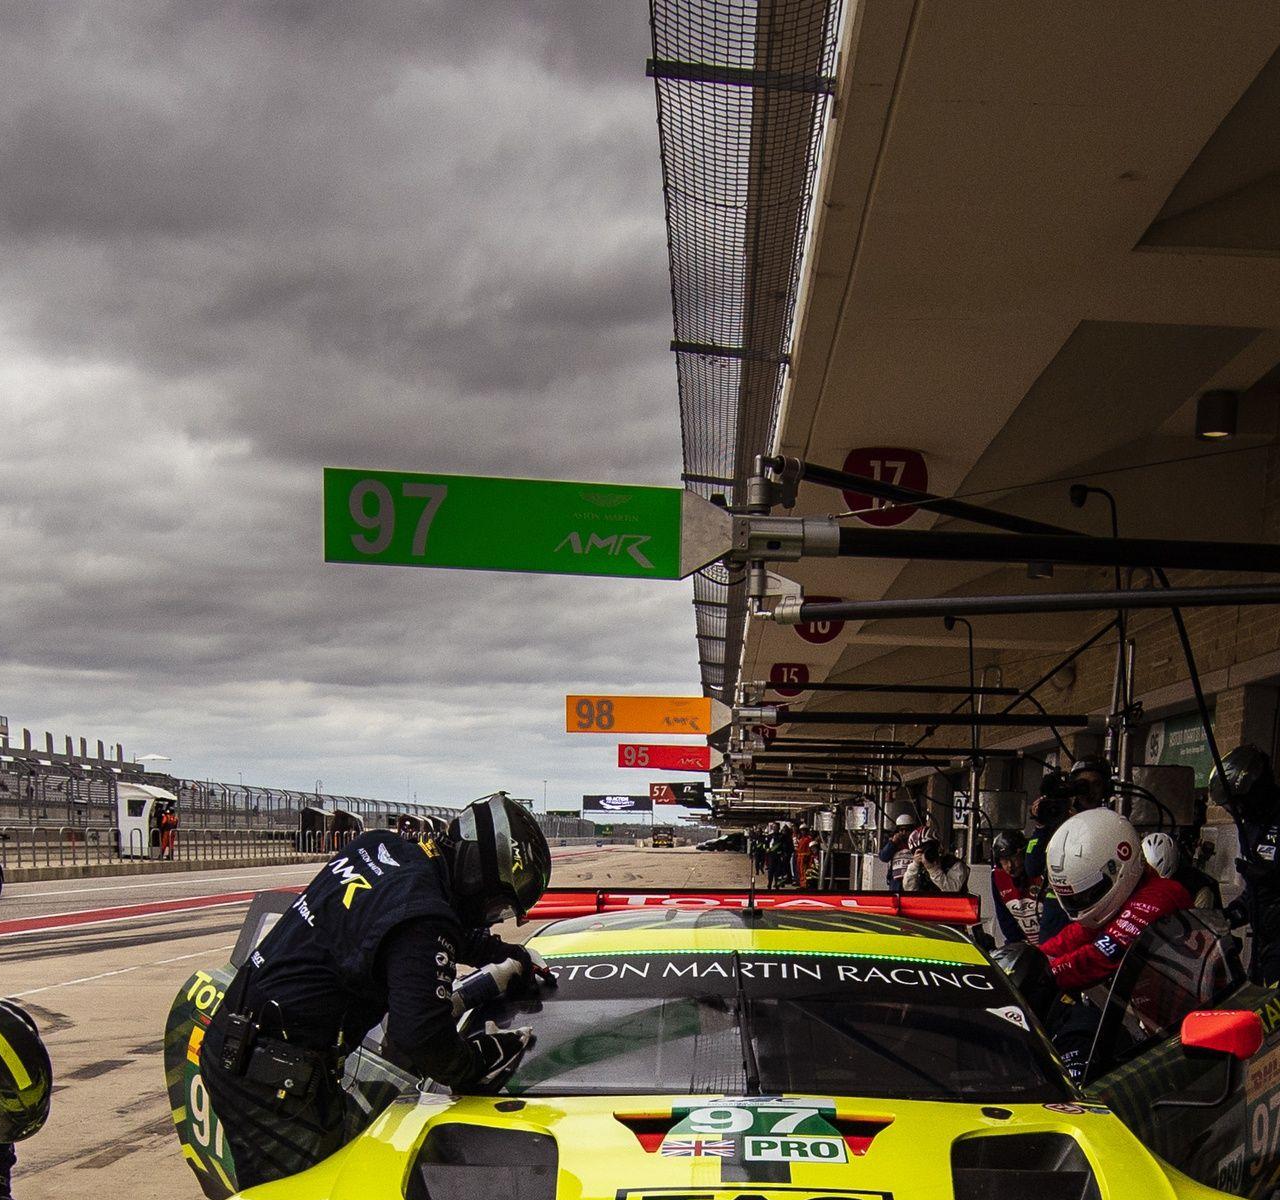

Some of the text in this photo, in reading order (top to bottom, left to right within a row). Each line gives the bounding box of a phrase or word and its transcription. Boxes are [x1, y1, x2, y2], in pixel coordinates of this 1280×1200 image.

[869, 460, 907, 509] 17
[348, 478, 448, 556] 97
[573, 511, 639, 522] ASTON MARTIN
[553, 531, 655, 569] AMR
[781, 667, 799, 683] 15
[575, 698, 615, 730] 98
[623, 746, 650, 767] 95
[329, 857, 373, 910] AMR
[608, 894, 878, 908] TOTAL
[550, 960, 995, 991] STON MARTIN RACING
[187, 970, 225, 1017] TOT
[688, 1107, 819, 1134] 97
[751, 1140, 840, 1159] PRO
